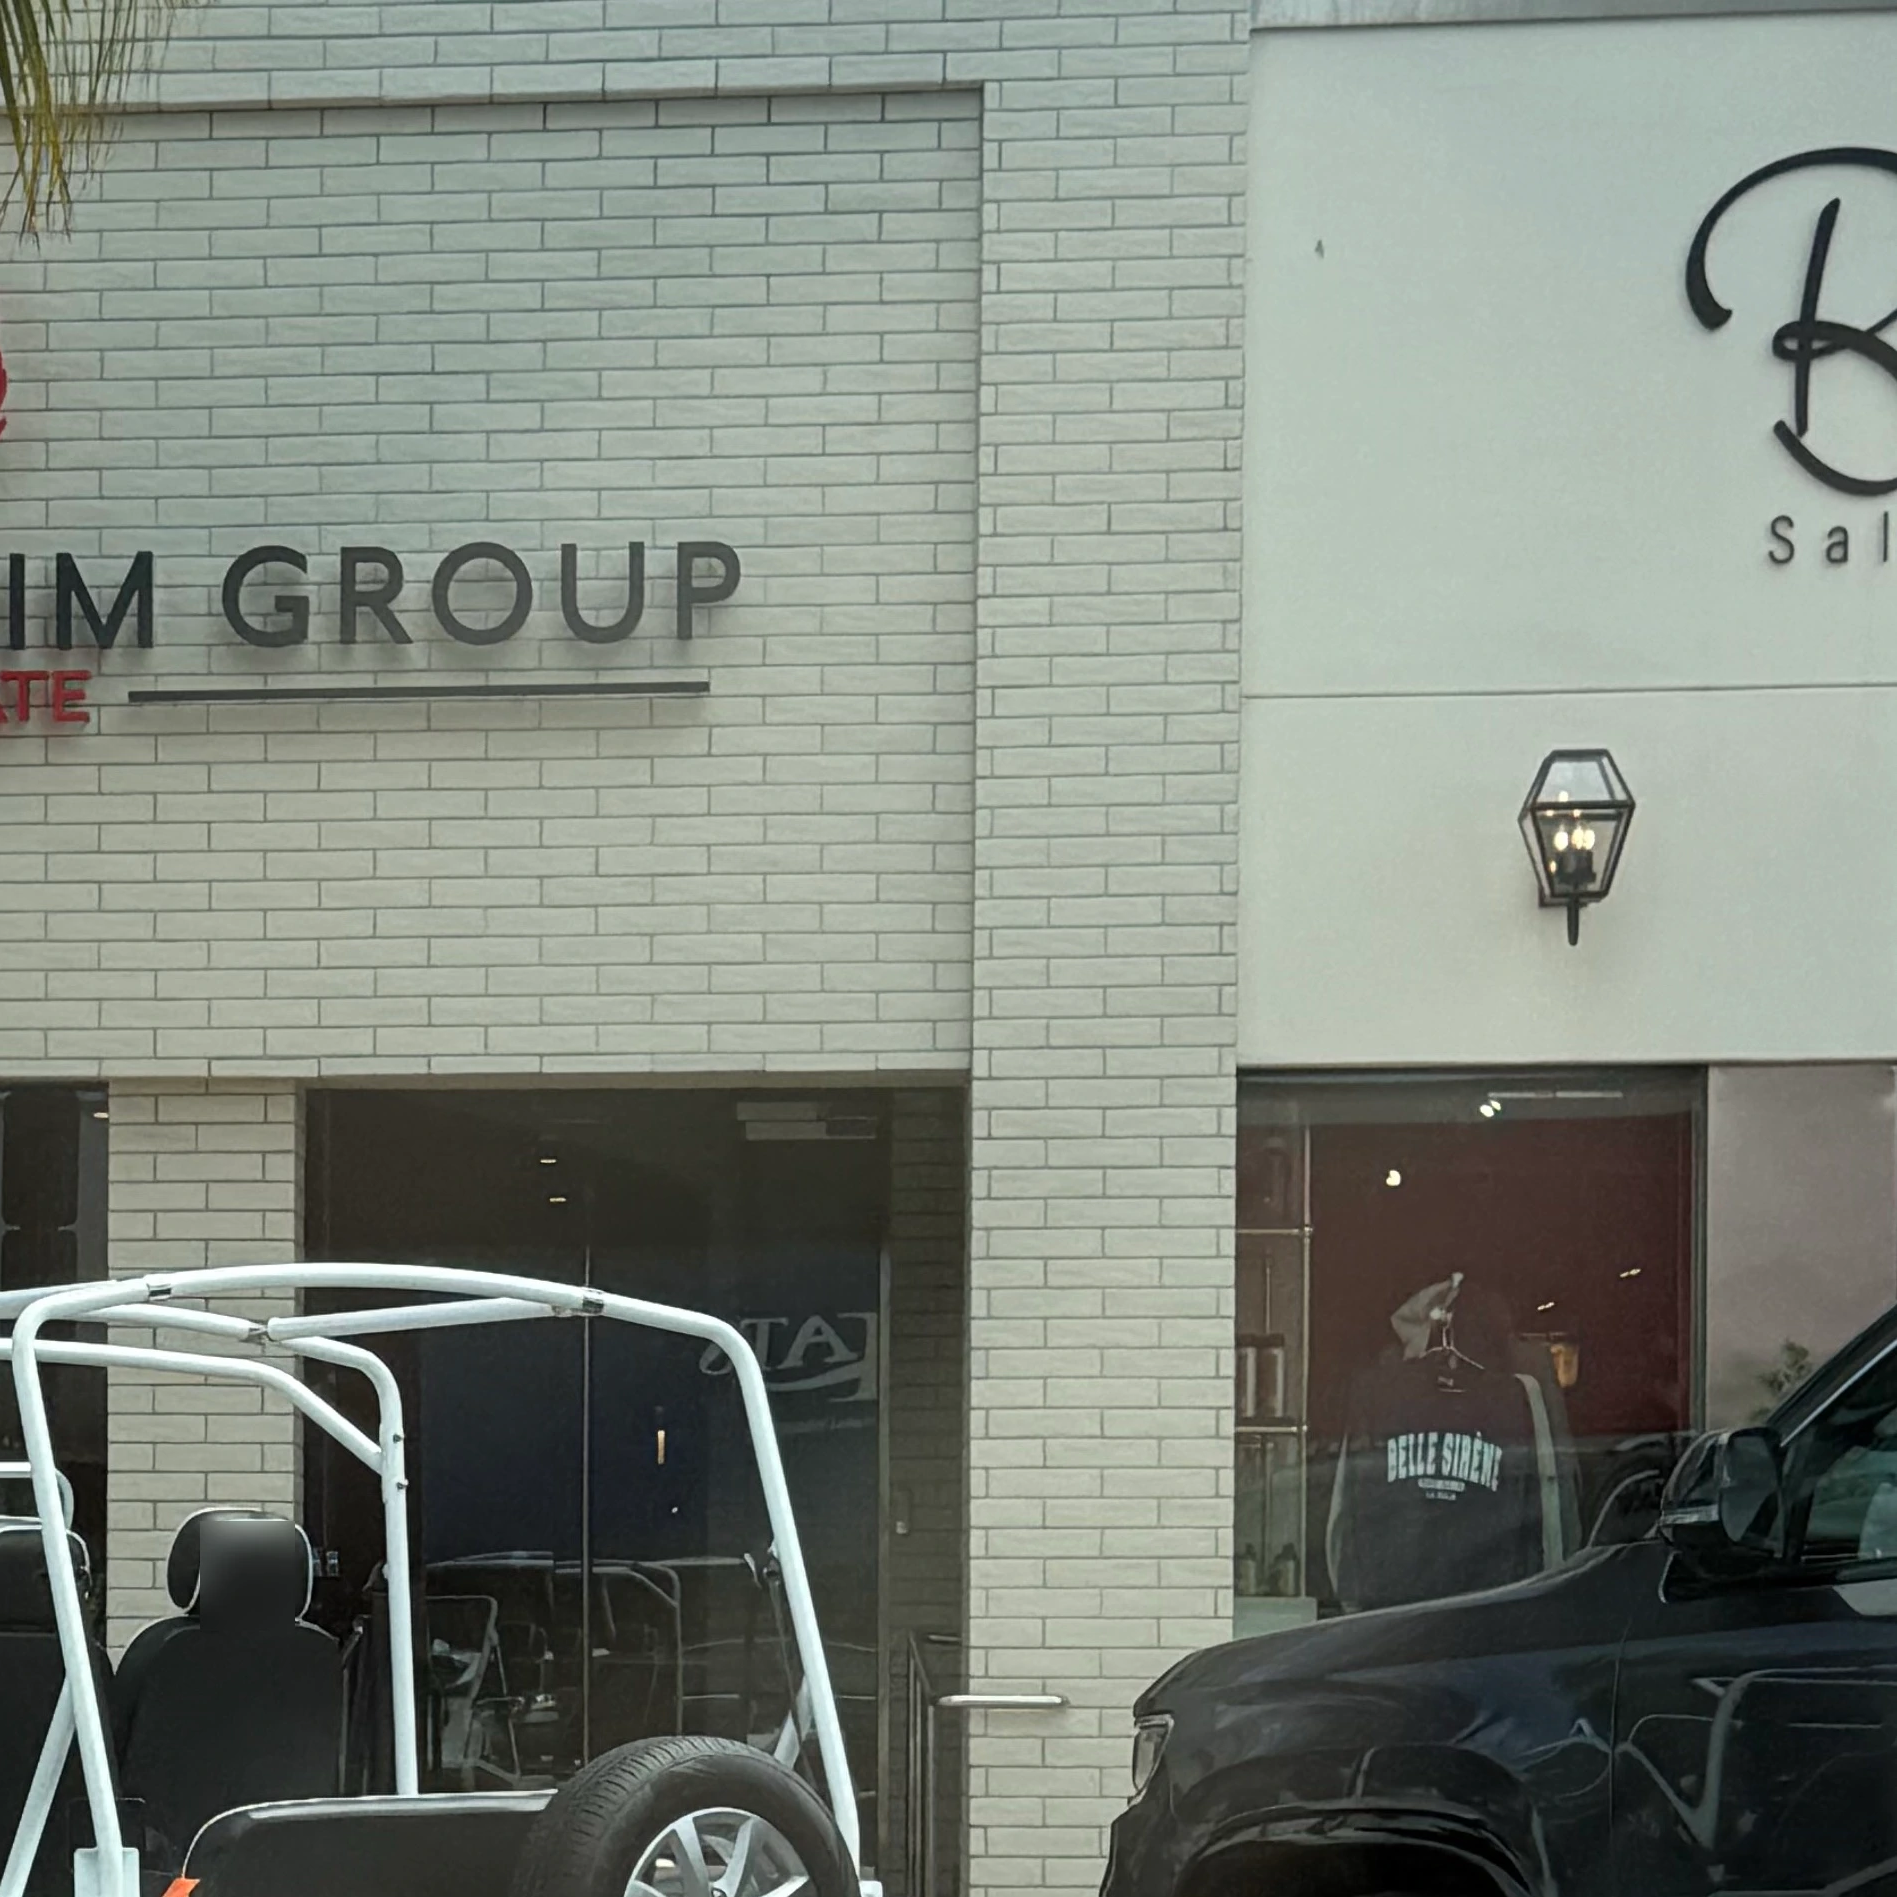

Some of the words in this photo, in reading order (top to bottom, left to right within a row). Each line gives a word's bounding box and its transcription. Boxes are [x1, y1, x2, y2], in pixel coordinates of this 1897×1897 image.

[1768, 511, 1890, 566] Sal
[222, 541, 741, 647] GROUP
[1387, 1431, 1438, 1483] BELLE
